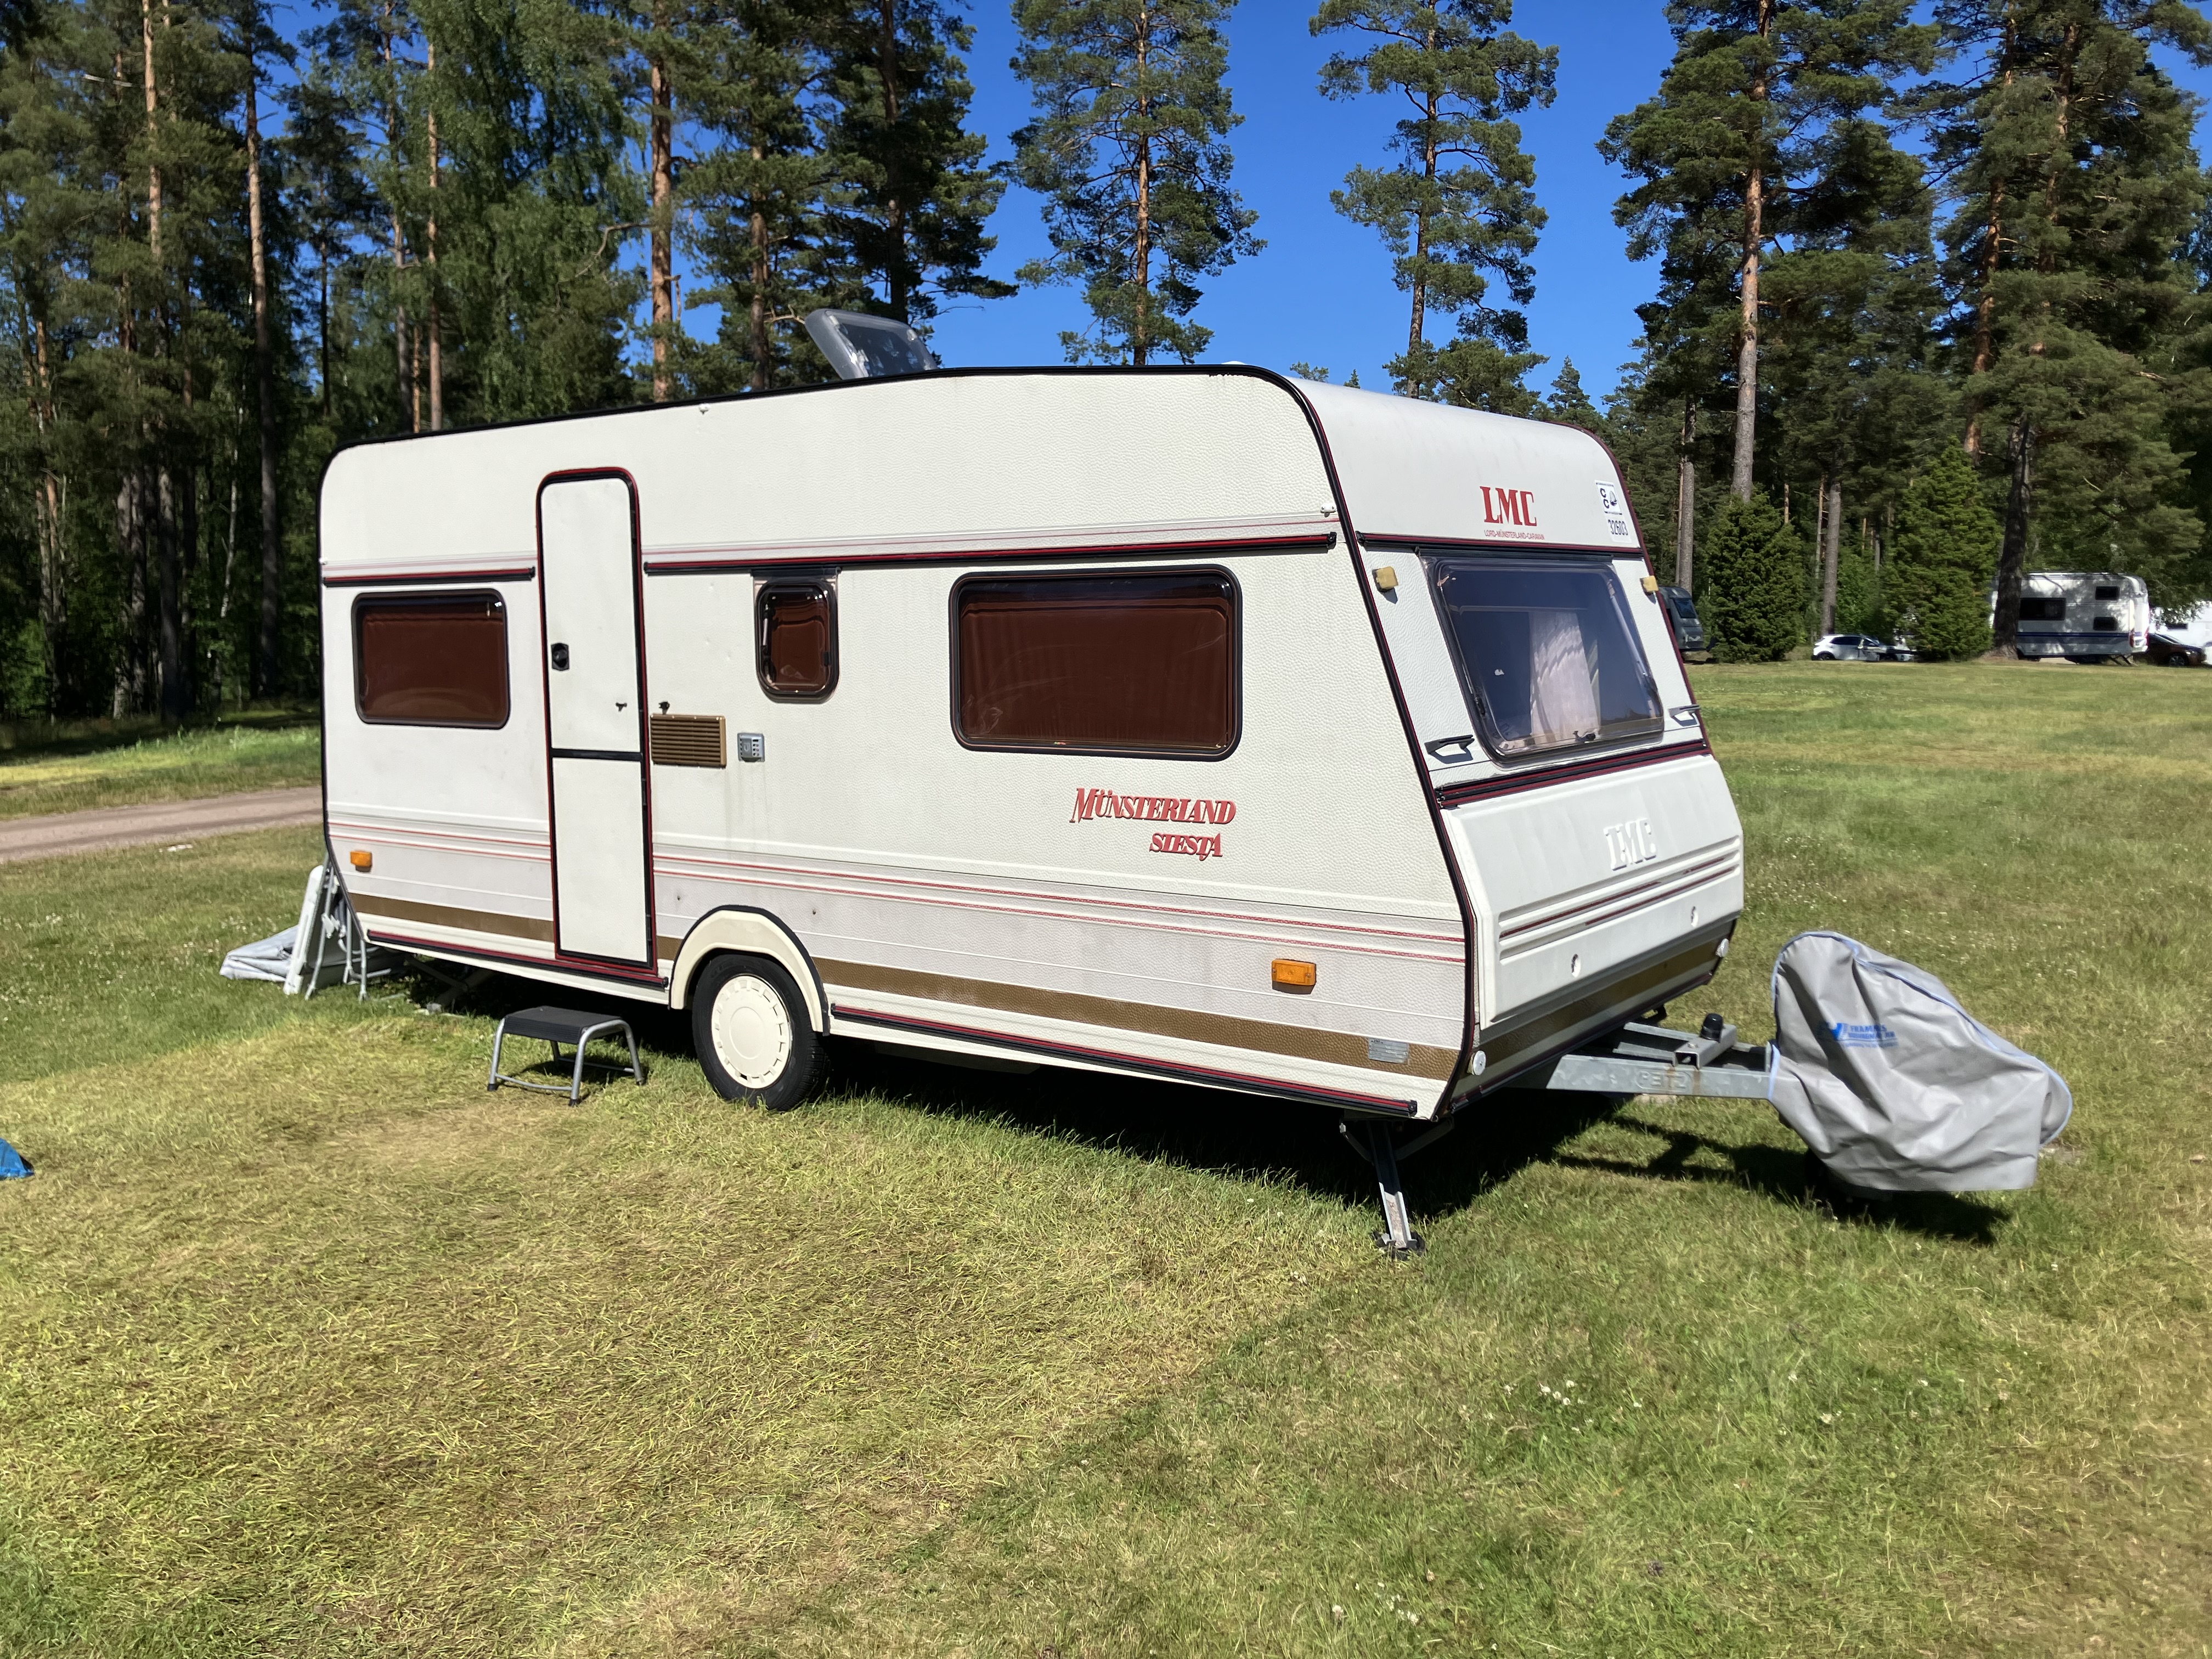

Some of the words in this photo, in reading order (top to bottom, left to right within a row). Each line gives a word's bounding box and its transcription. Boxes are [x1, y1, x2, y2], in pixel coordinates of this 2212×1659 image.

[1480, 486, 1537, 527] LMC
[1600, 488, 1606, 498] C
[1603, 499, 1610, 509] C
[1608, 519, 1628, 535] 32603
[1069, 788, 1237, 825] MÜNSTERLAND
[1149, 832, 1223, 861] SIESTA
[1603, 817, 1656, 871] LMC
